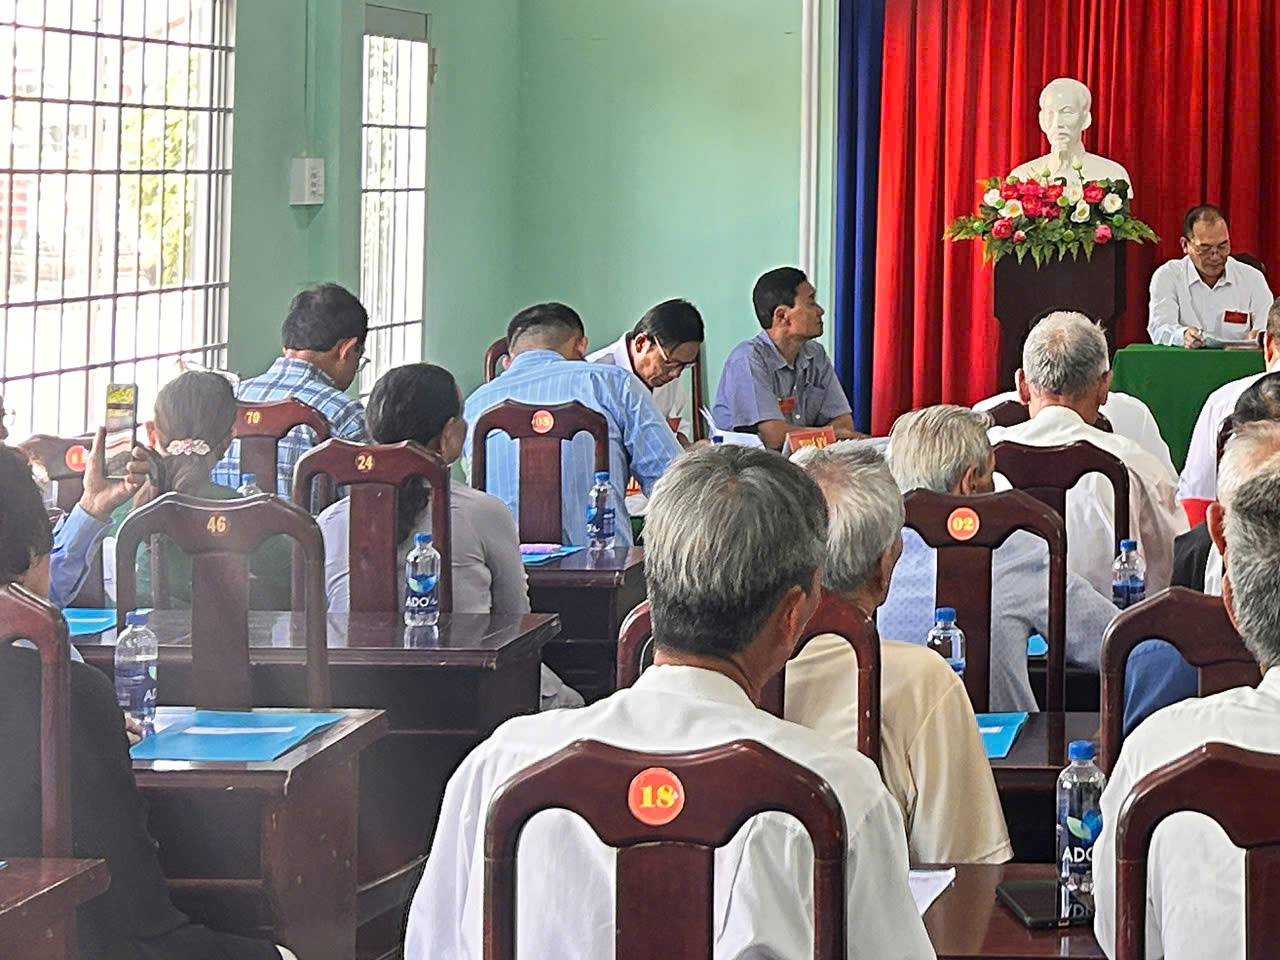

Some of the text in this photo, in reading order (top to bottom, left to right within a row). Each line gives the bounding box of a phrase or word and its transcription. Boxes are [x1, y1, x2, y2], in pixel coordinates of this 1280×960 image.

[246, 411, 260, 424] 70
[357, 455, 373, 470] 24
[207, 515, 227, 532] 46
[639, 784, 676, 808] 18
